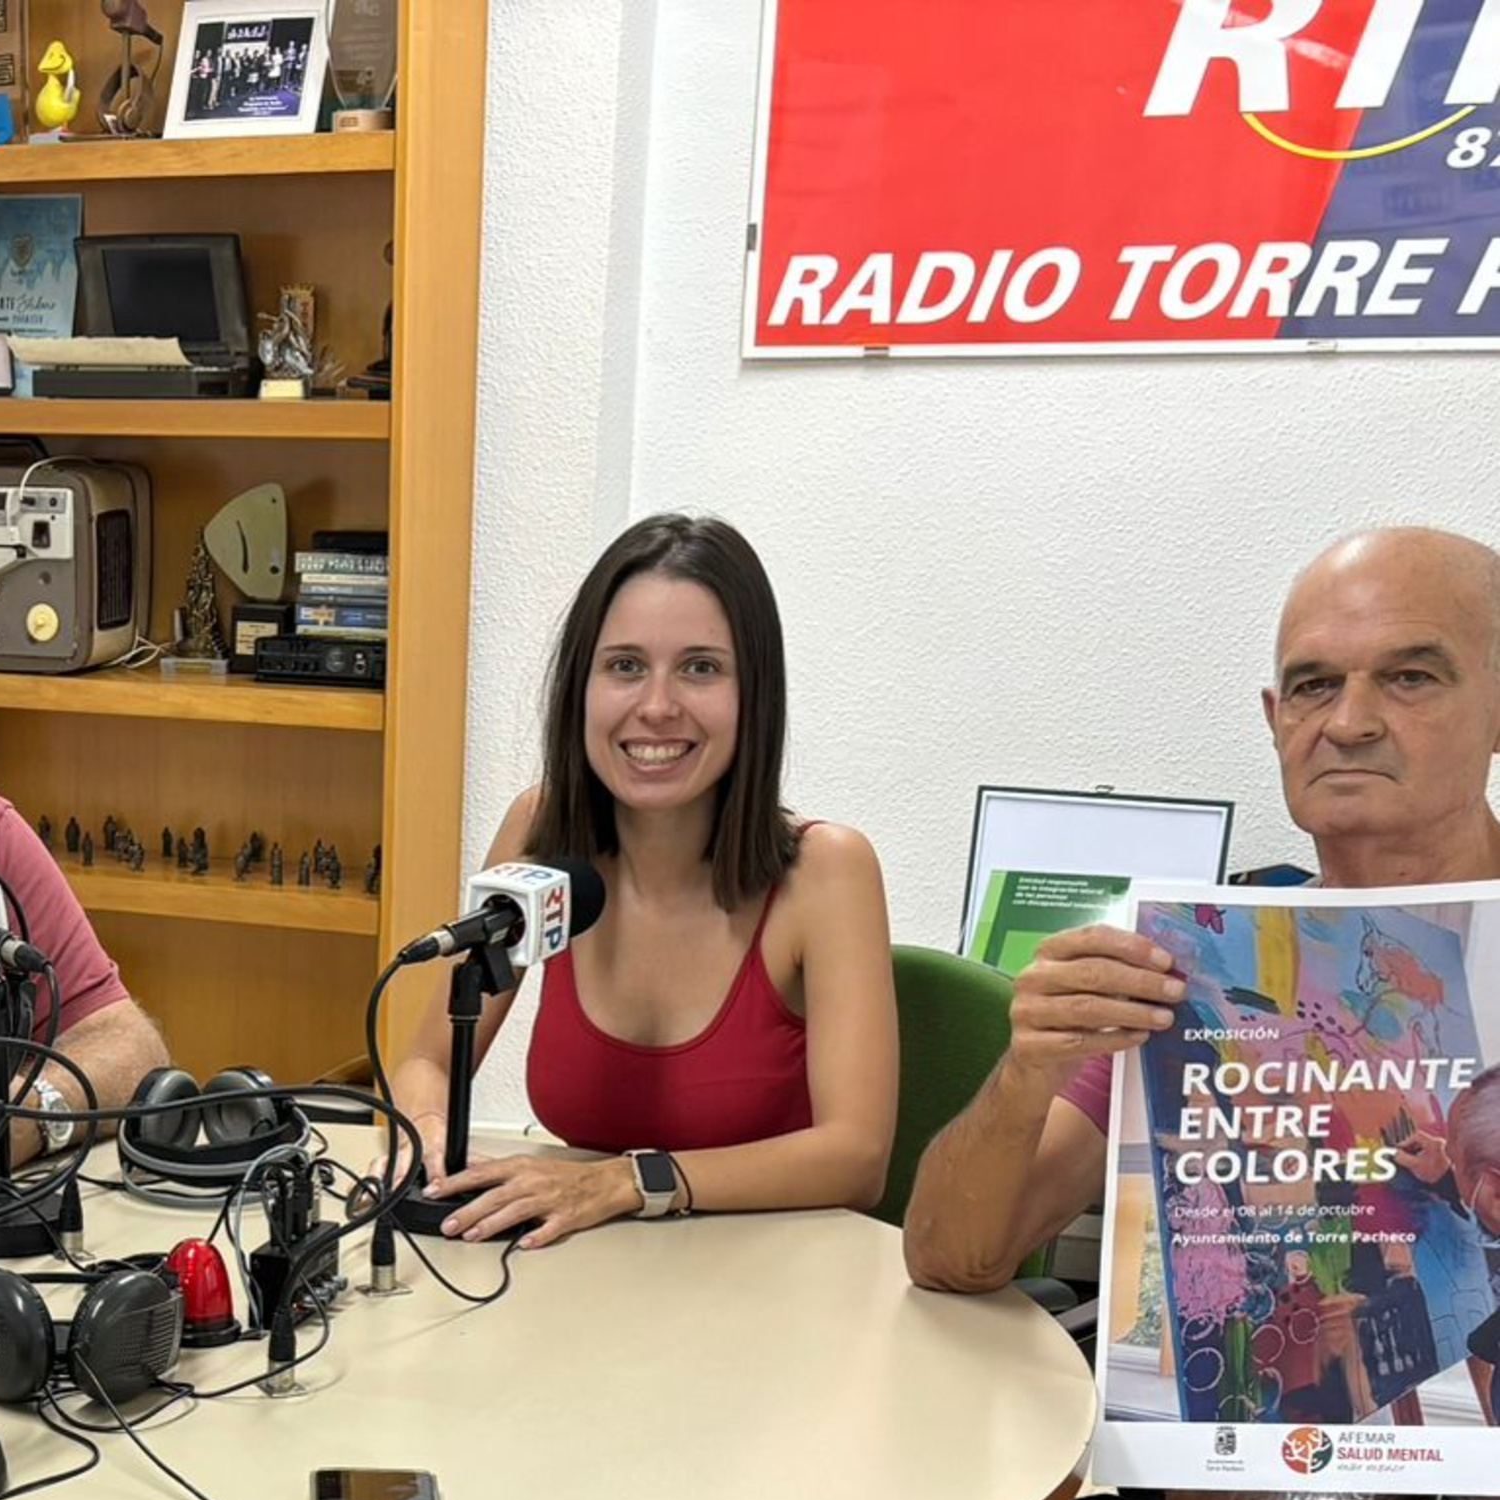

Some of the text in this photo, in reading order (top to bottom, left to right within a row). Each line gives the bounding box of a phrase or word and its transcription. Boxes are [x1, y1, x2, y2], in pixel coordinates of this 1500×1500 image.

[767, 245, 1082, 326] RADIO
[1109, 237, 1450, 321] TORRE
[545, 886, 564, 950] RTP
[1184, 1026, 1279, 1041] EXPOSICIÓN
[1182, 1057, 1477, 1096] ROCINANTE
[1179, 1103, 1333, 1140] ENTRE
[1175, 1148, 1397, 1184] COLORES
[1175, 1206, 1218, 1218] Desde
[1224, 1205, 1235, 1217] el
[1259, 1205, 1272, 1216] al
[1277, 1205, 1294, 1216] 14
[1297, 1204, 1315, 1216] de
[1318, 1203, 1375, 1216] octubre
[1171, 1230, 1417, 1247] Ayuntamiento de Torre Pacheco
[1338, 1431, 1395, 1444] AFEMAR
[1337, 1447, 1443, 1462] SALUD MENTAL
